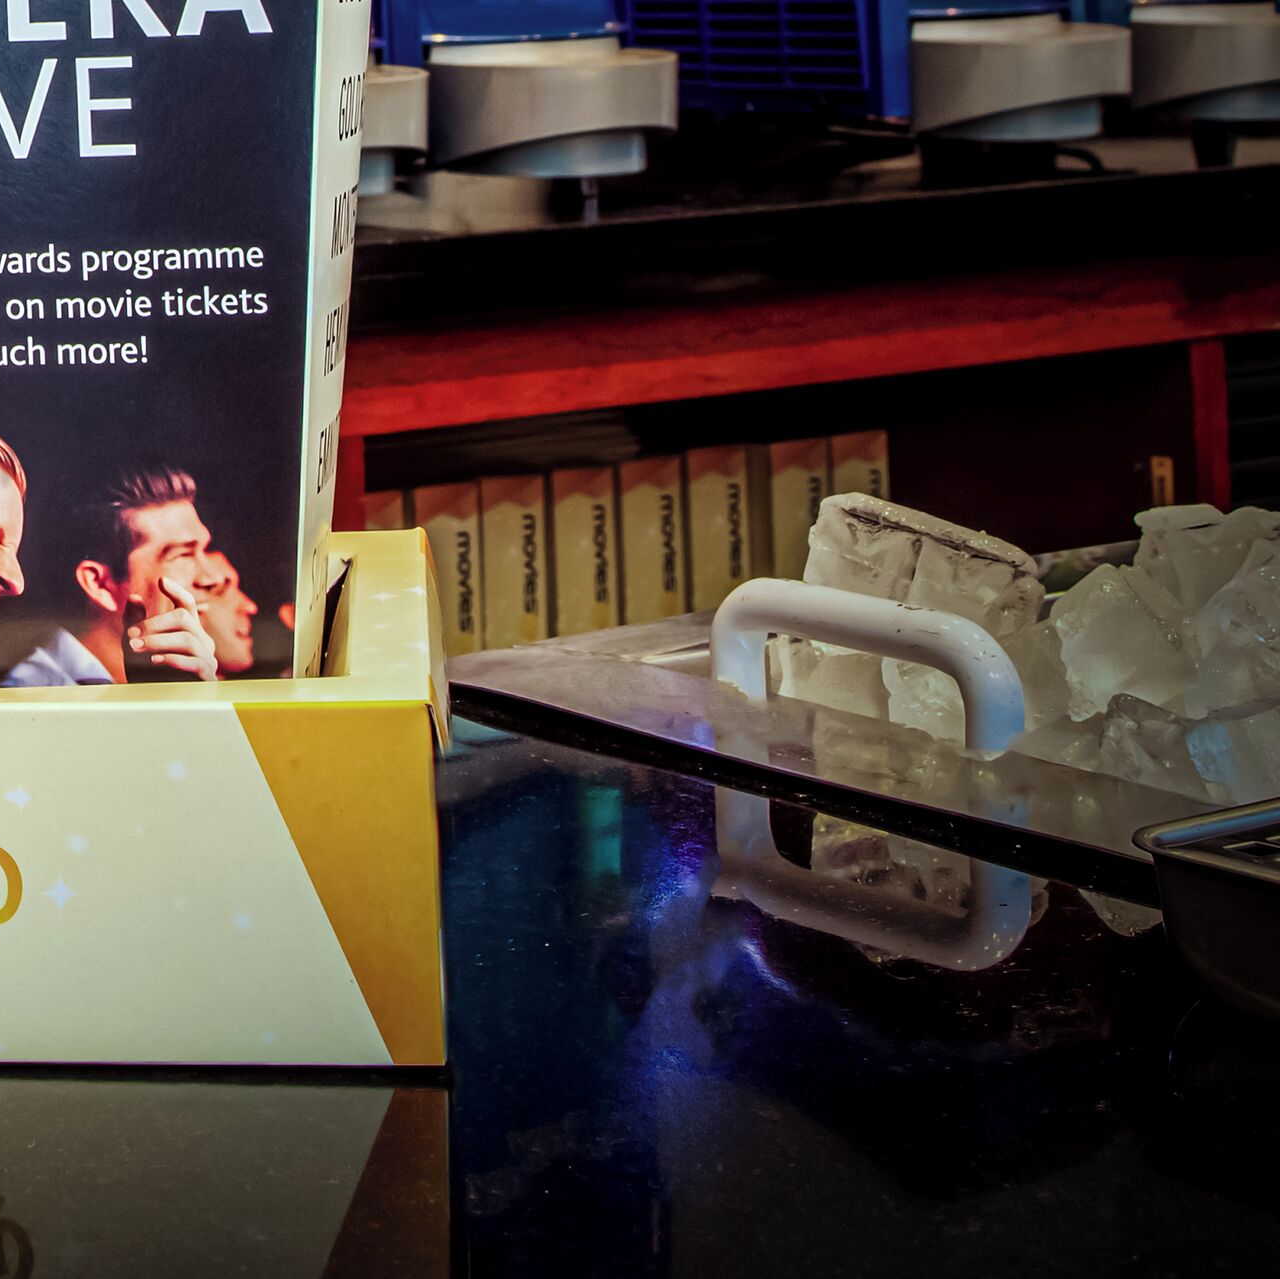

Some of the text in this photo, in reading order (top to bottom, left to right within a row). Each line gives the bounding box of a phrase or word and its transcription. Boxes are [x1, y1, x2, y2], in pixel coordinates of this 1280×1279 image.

[81, 244, 264, 281] programme
[5, 296, 45, 320] on
[55, 289, 152, 319] movie
[162, 285, 268, 317] tickets
[57, 336, 149, 365] more!
